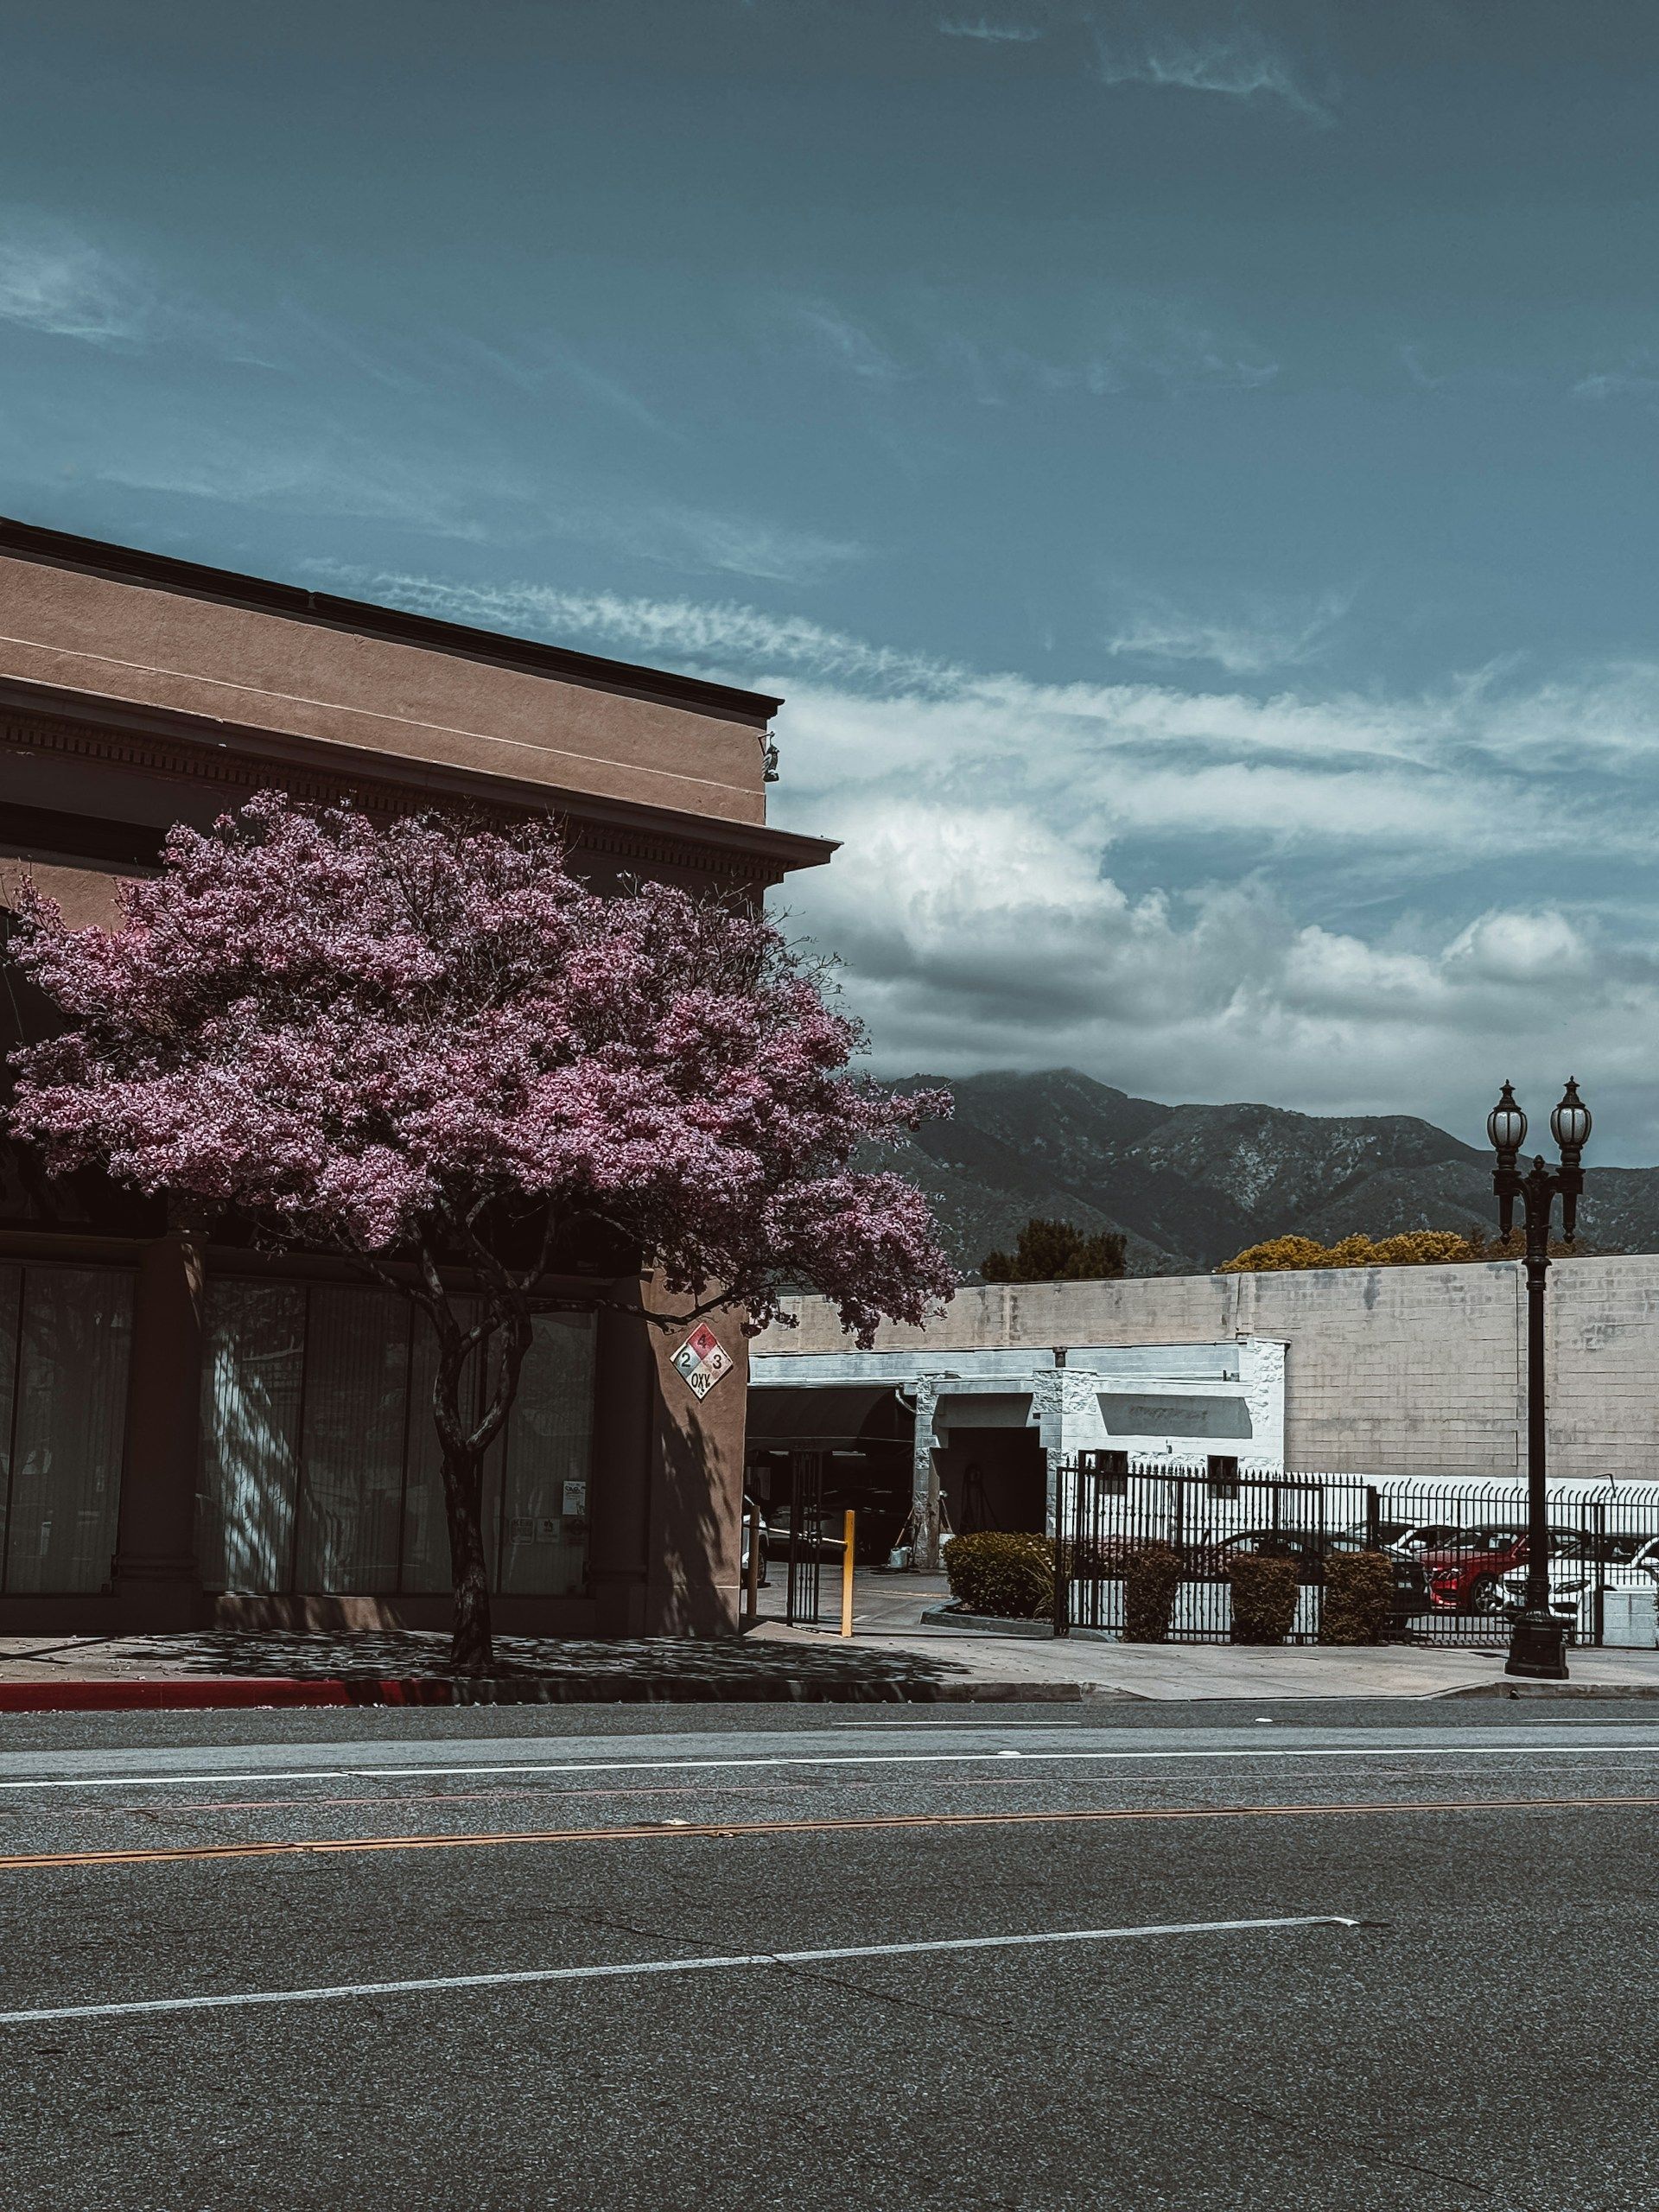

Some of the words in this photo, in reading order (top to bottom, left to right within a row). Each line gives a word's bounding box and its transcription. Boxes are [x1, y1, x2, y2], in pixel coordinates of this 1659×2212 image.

[697, 1334, 707, 1349] 4
[681, 1352, 690, 1368] 2
[712, 1354, 721, 1370] 3
